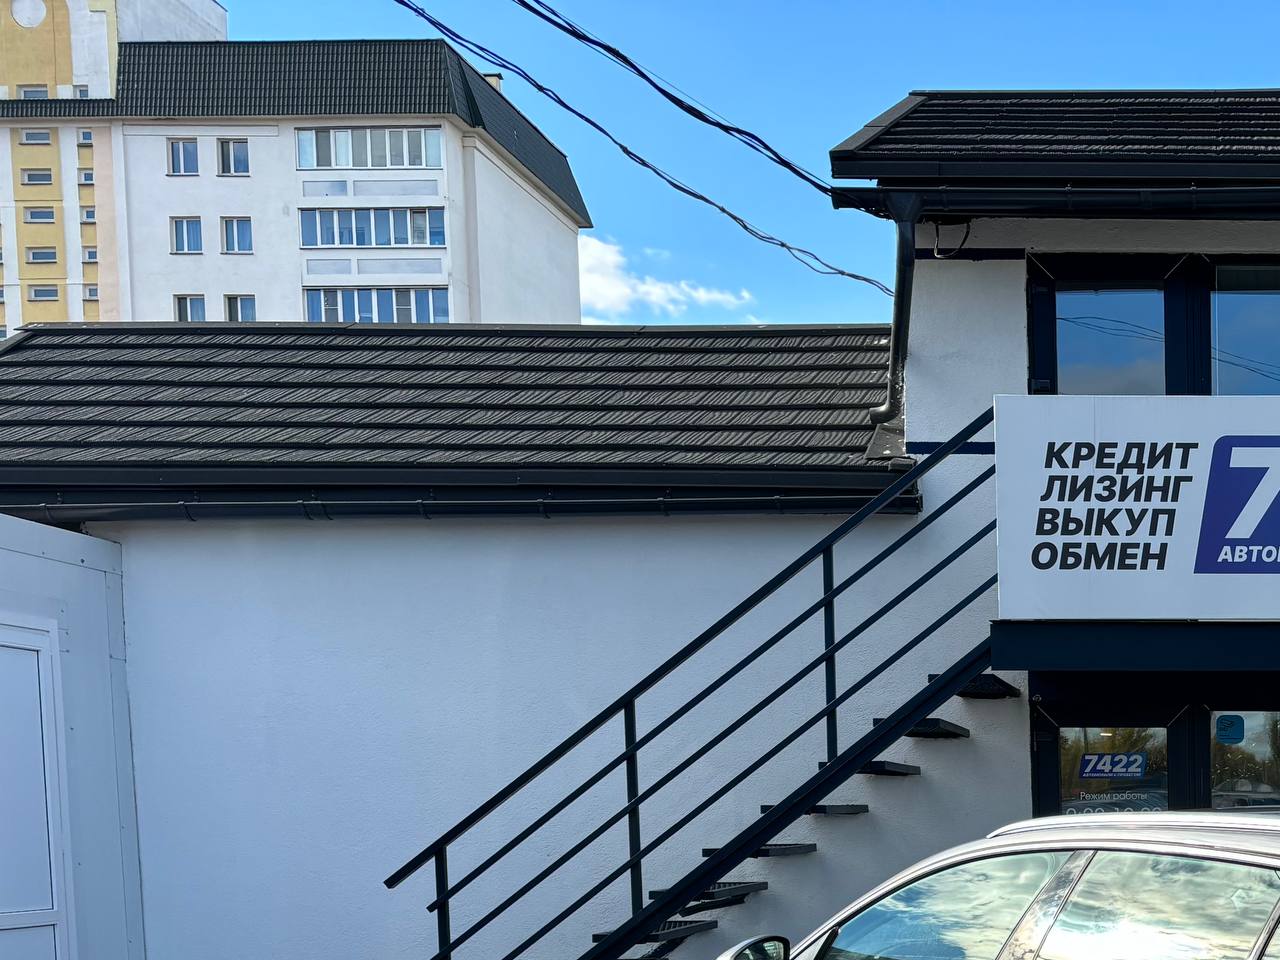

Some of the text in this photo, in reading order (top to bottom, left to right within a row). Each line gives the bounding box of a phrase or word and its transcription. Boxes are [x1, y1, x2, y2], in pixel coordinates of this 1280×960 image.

[1043, 441, 1199, 473] КРЕДИТ
[1040, 474, 1193, 503] ЛИЗИНГ
[1035, 508, 1177, 537] ВЫКУП
[1030, 541, 1169, 571] ОБМЕН
[1084, 754, 1143, 773] 7422
[1080, 790, 1148, 801] Режим работы
